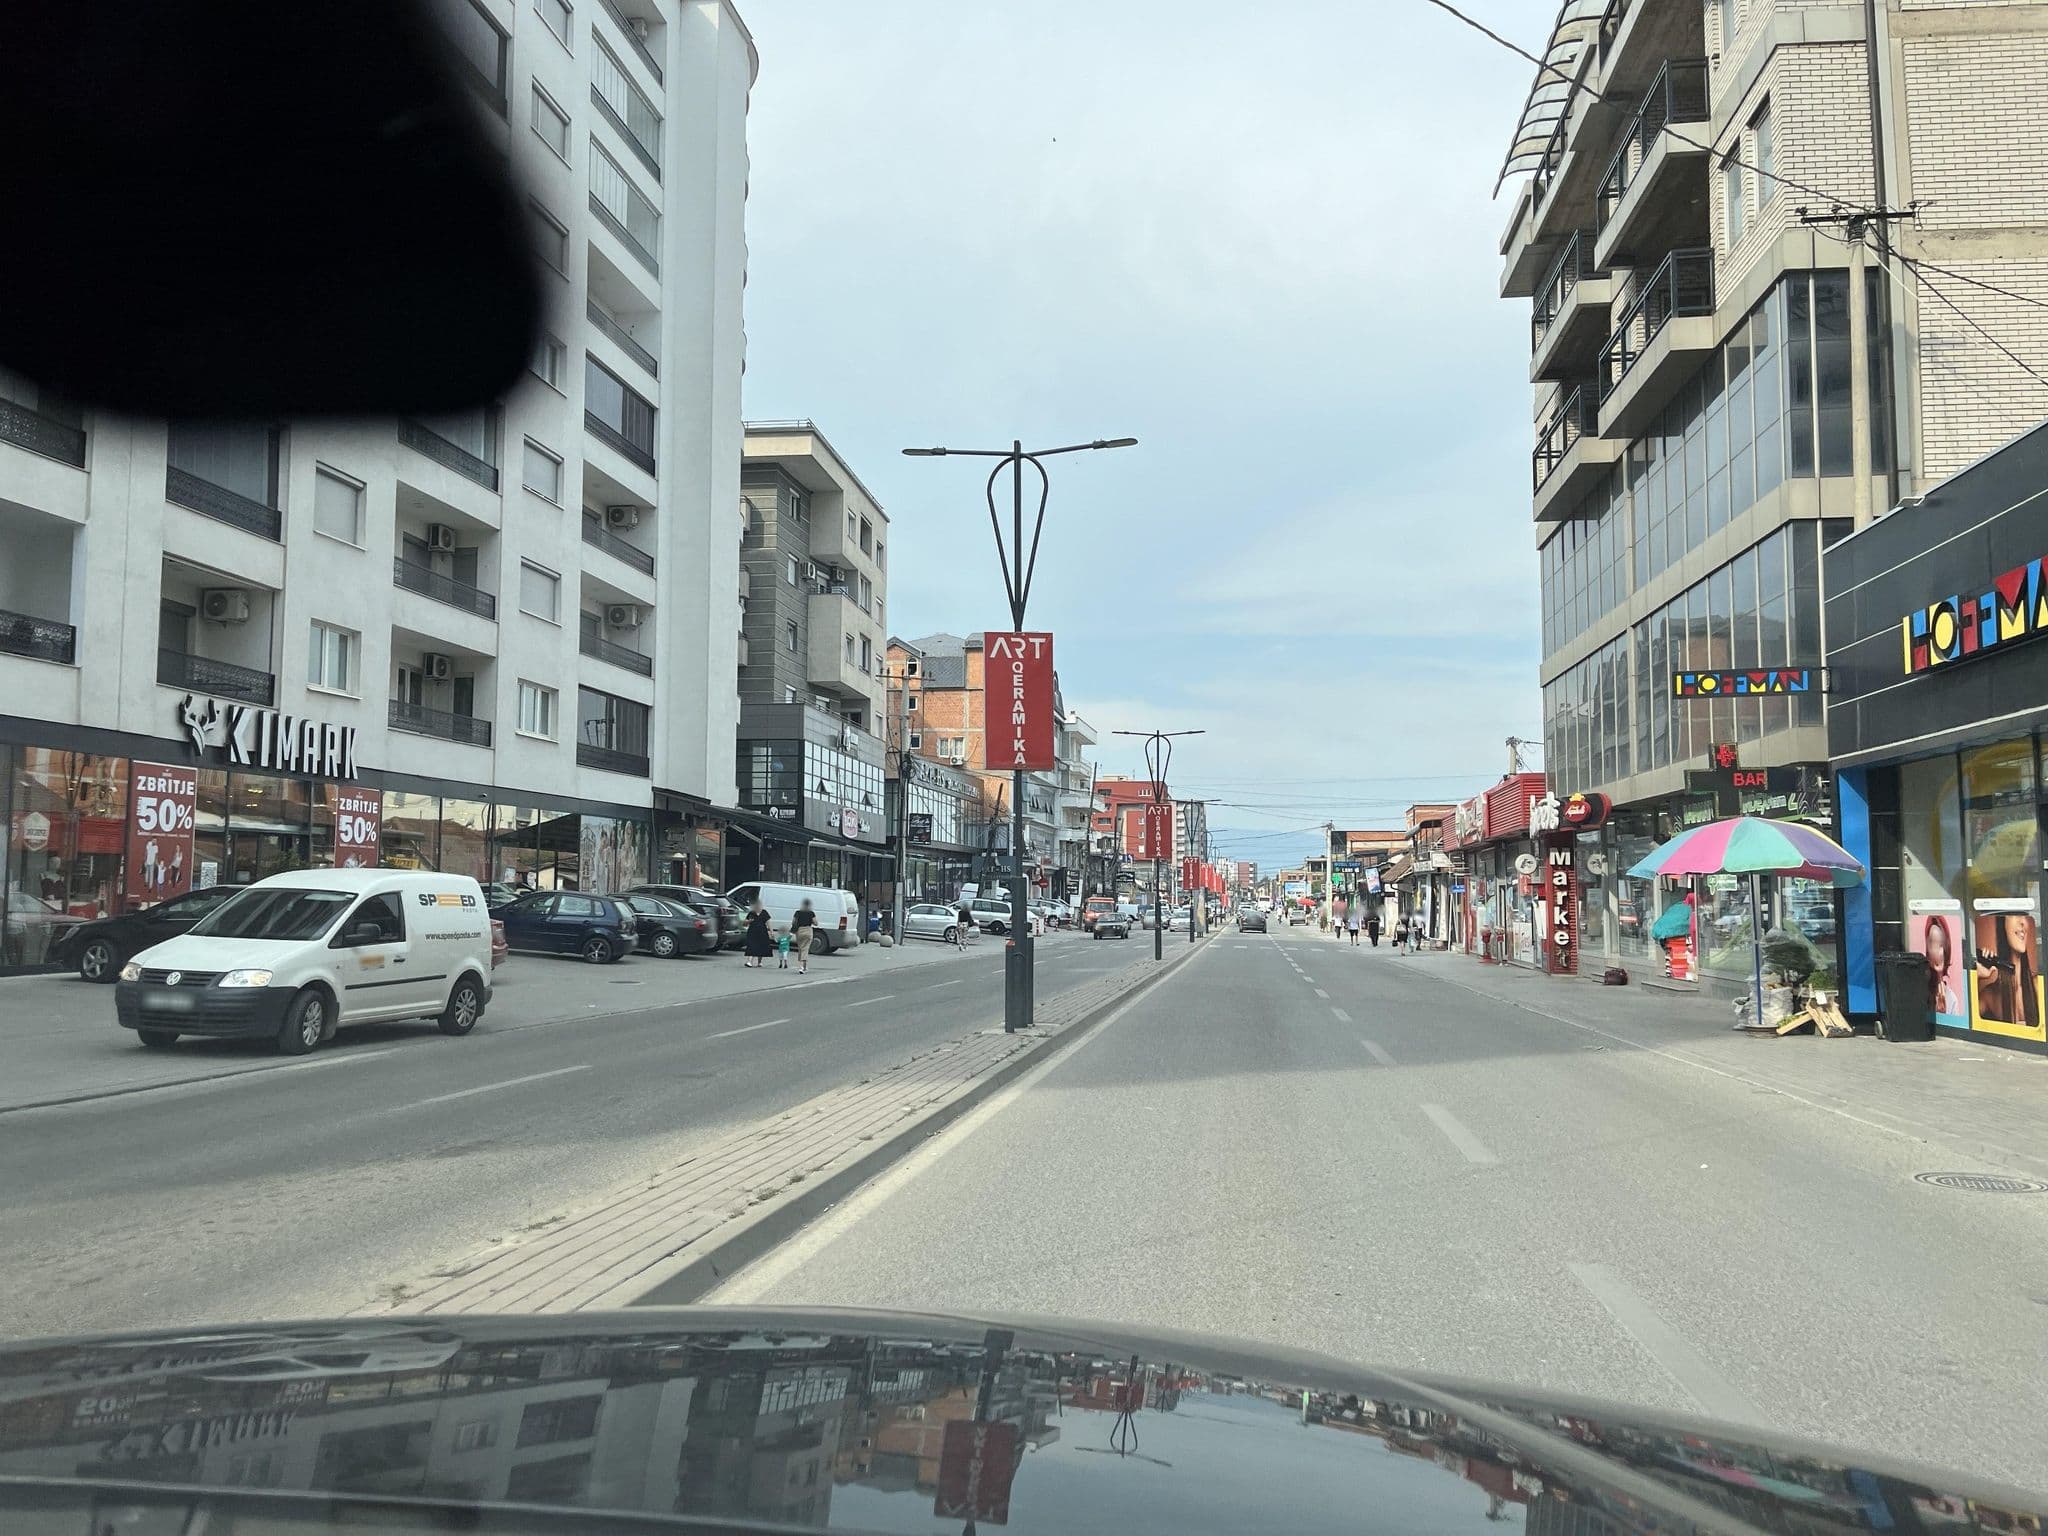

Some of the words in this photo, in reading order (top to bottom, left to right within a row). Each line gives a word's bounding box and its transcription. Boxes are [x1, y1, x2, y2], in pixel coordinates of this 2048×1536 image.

[989, 637, 1046, 659] ART
[1676, 671, 1808, 695] HOFFMAN
[1011, 661, 1026, 765] QERAMIKA
[229, 705, 358, 780] KIMARK
[137, 775, 195, 796] ZBRITJE
[1733, 772, 1767, 787] BAR
[136, 796, 193, 832] 50%
[339, 797, 378, 814] ZBRITJE
[1147, 806, 1170, 815] ART
[338, 814, 377, 844] 50%
